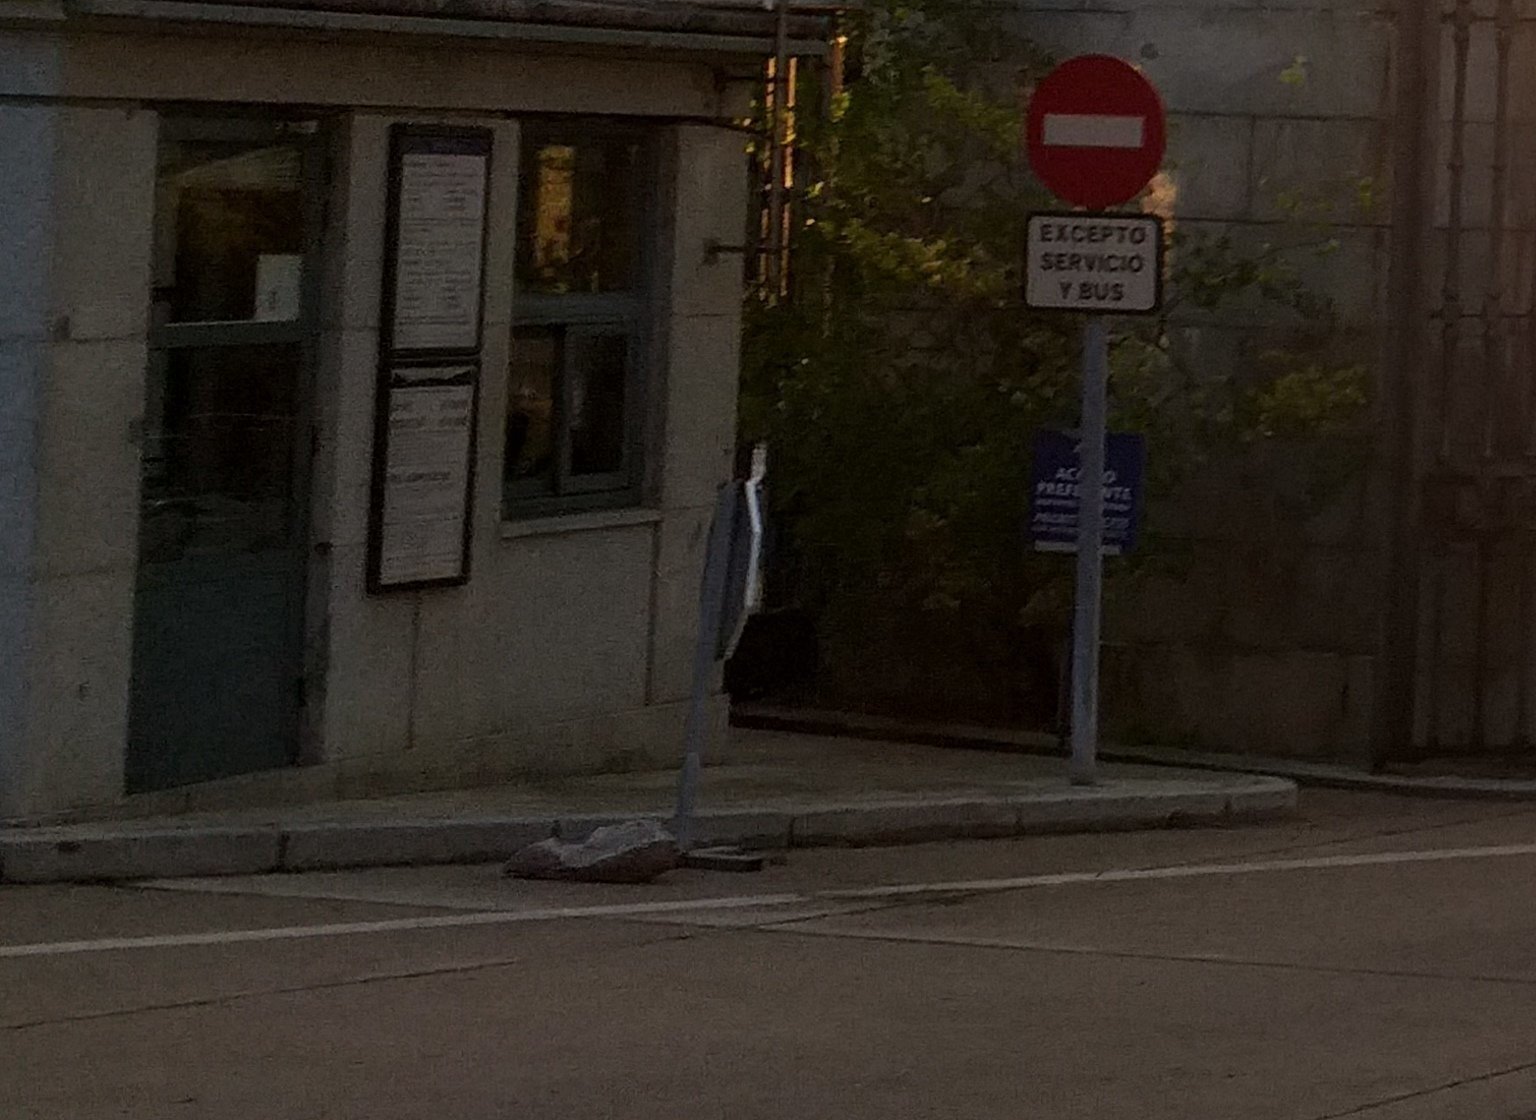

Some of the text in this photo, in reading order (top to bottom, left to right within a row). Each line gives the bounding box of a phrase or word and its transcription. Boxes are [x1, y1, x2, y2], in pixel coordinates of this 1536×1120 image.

[1040, 223, 1146, 244] EXCEPTO
[1040, 252, 1144, 273] SERVICIO
[1059, 281, 1125, 301] Y BUS
